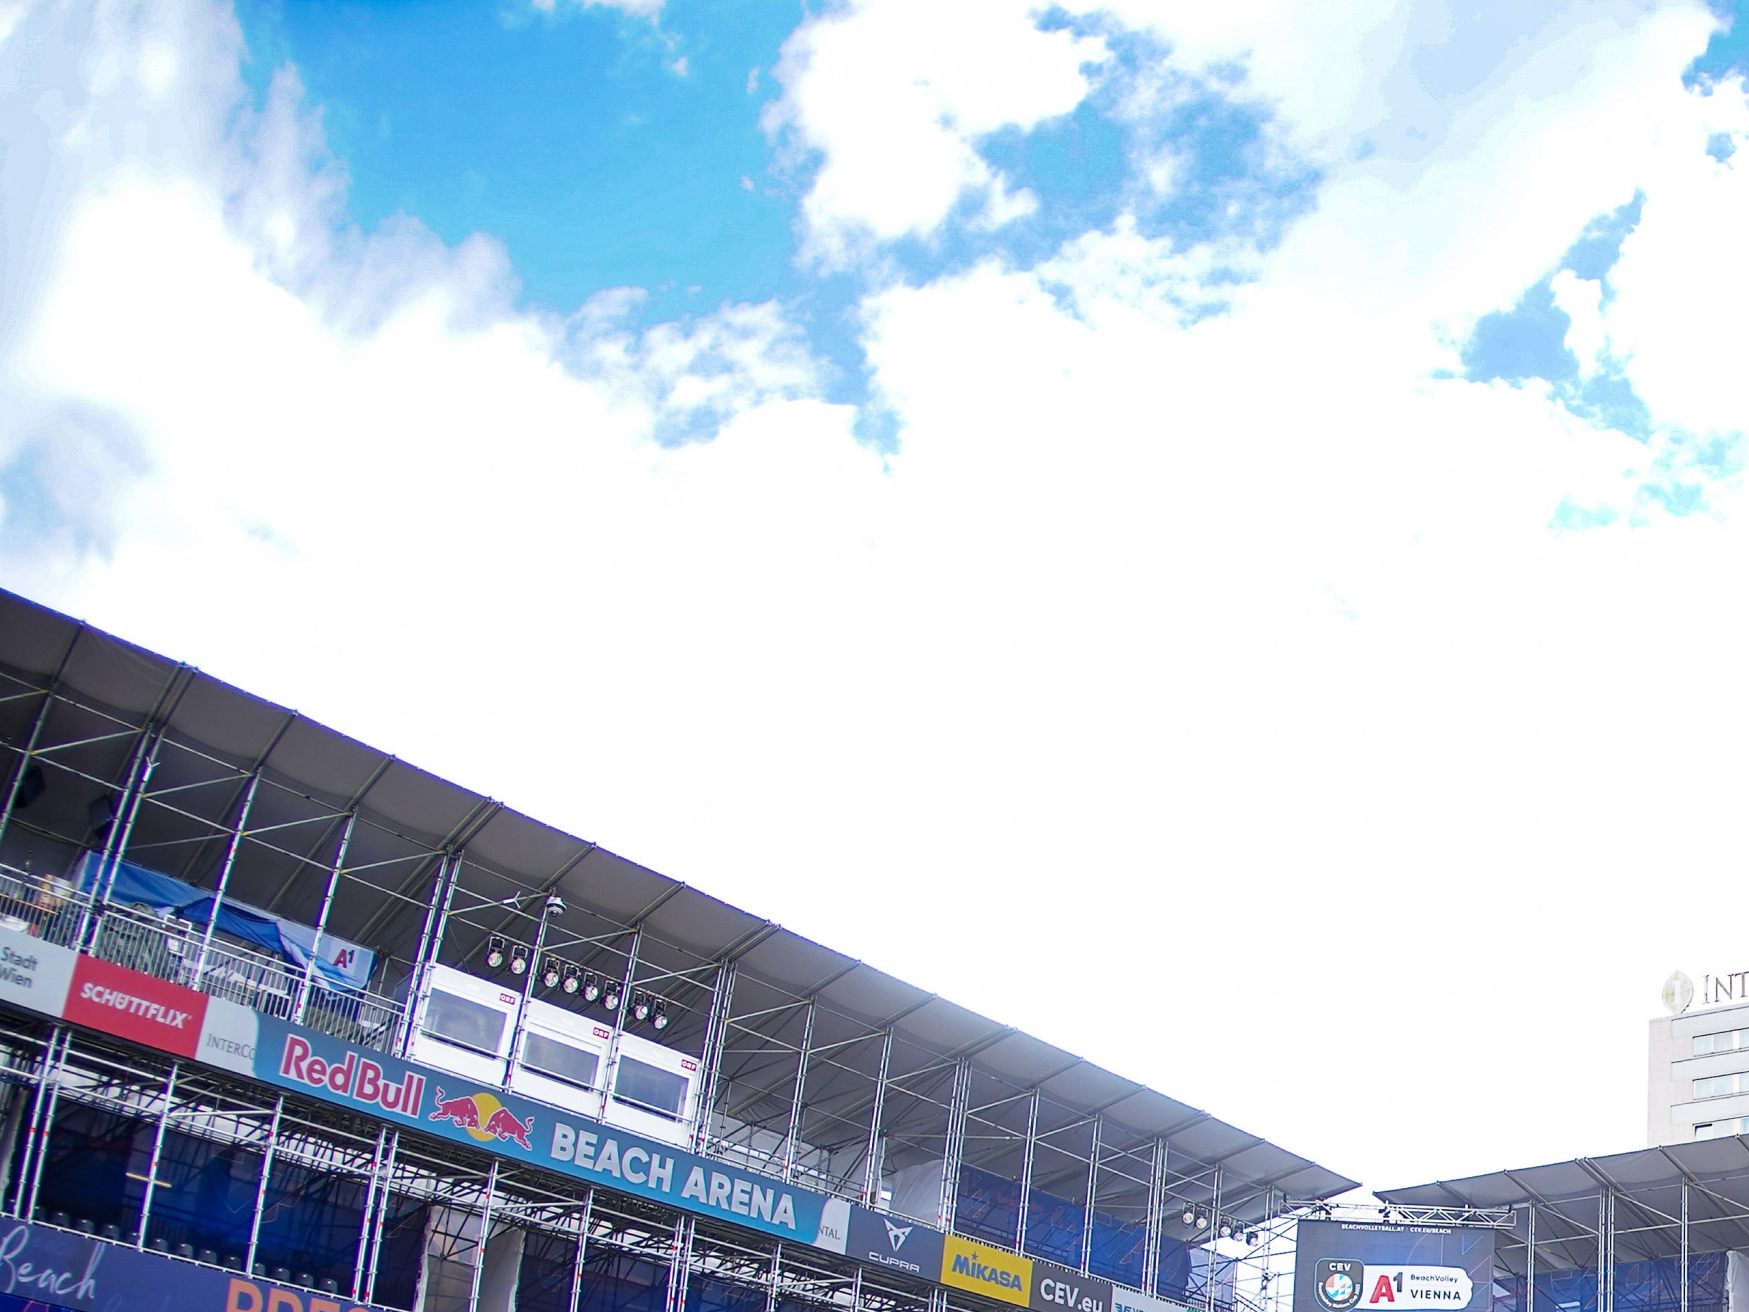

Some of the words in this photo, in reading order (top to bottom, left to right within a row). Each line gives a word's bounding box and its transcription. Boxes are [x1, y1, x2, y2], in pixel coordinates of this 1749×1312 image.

[0, 947, 38, 971] Stadt
[333, 949, 355, 969] A1
[0, 963, 32, 989] Wien
[501, 994, 516, 1004] ORF
[594, 1028, 609, 1038] ORF
[682, 1060, 697, 1070] ORF
[279, 1033, 358, 1097] Red
[353, 1057, 426, 1119] Bull
[550, 1122, 675, 1193] BEACH
[680, 1166, 797, 1231] ARENA
[868, 1251, 920, 1274] CUPRA
[1329, 1262, 1351, 1271] CEV
[1370, 1272, 1403, 1303] A1
[1410, 1274, 1458, 1284] BeachVolley
[1411, 1289, 1461, 1300] VIENNA
